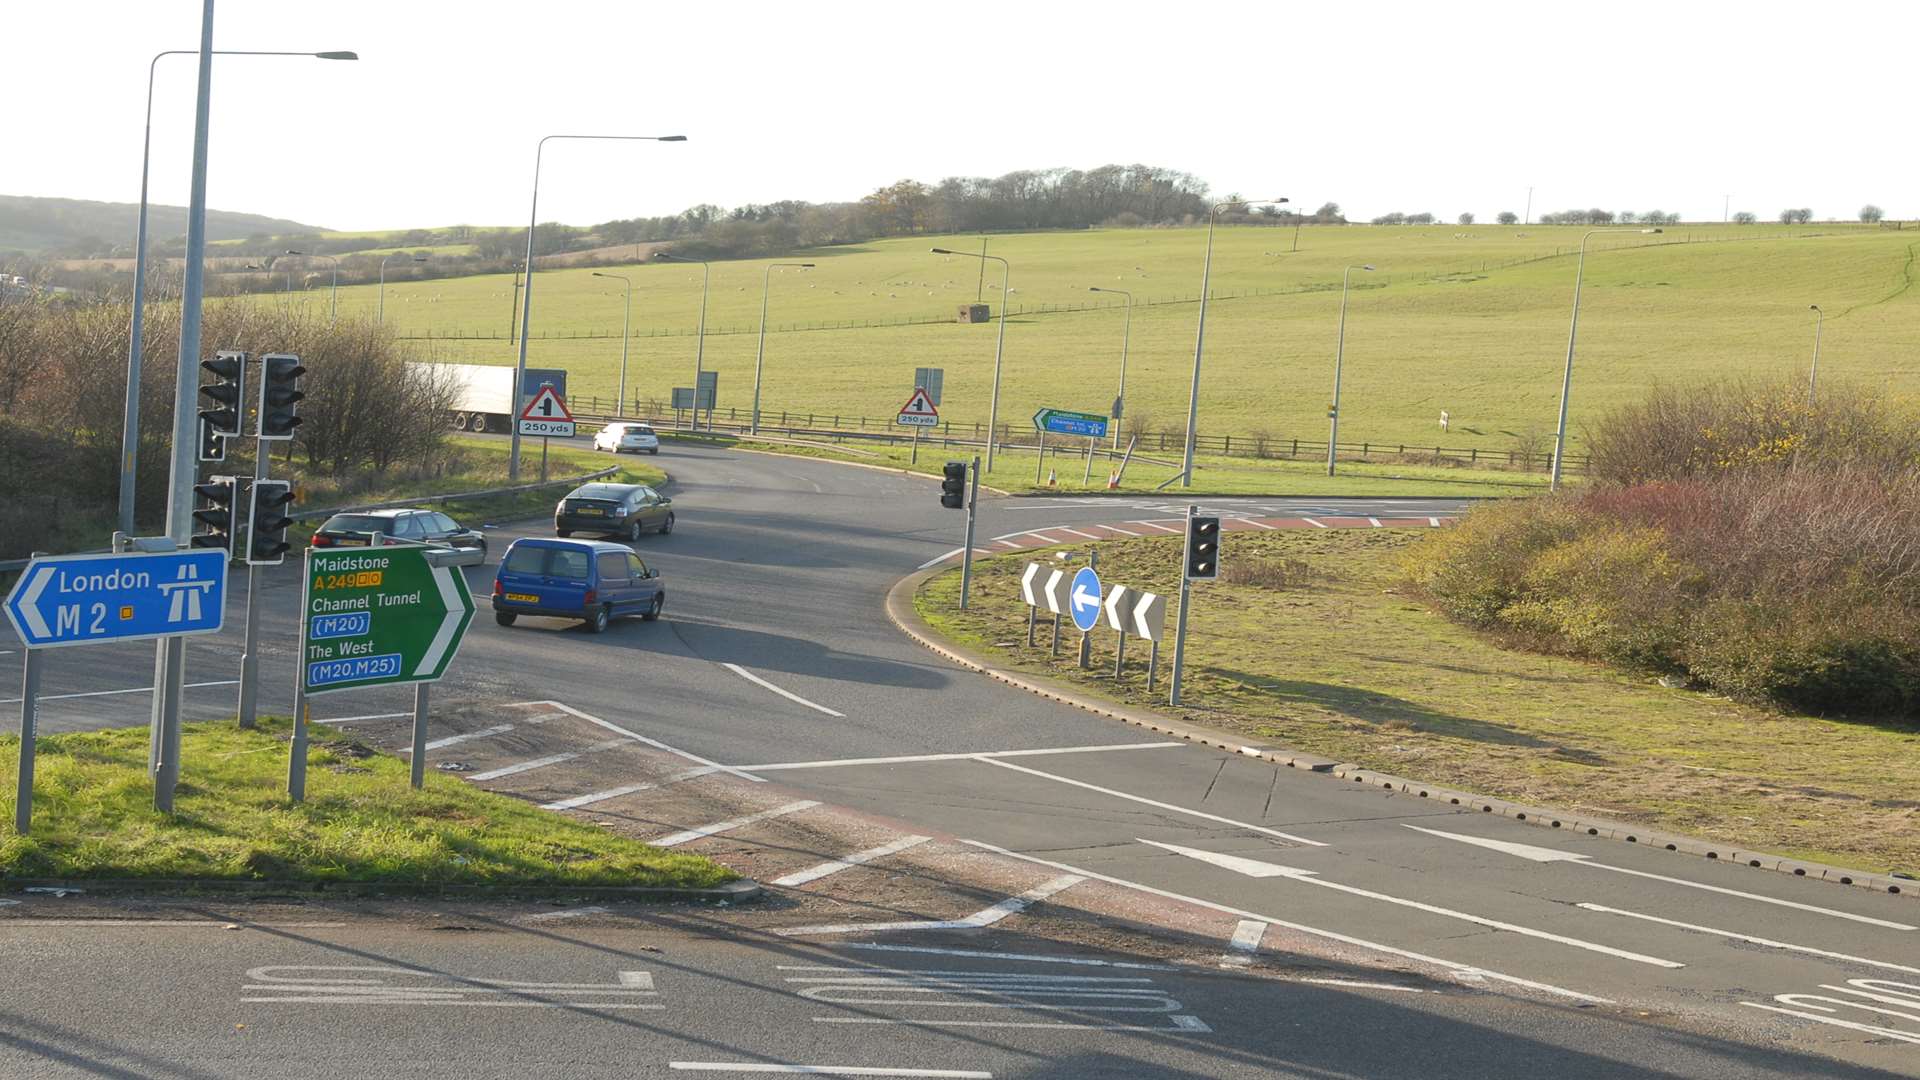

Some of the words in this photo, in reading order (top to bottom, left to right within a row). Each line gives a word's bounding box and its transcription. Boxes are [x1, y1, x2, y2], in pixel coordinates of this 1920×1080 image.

[525, 422, 548, 431] 250
[550, 424, 569, 433] yds
[902, 415, 919, 423] 250
[314, 556, 389, 572] Maidstone
[60, 568, 149, 593] London
[312, 594, 370, 612] Channel
[376, 590, 421, 607] Tunnel
[316, 616, 365, 636] (M20)
[309, 645, 333, 659] The
[339, 640, 375, 655] West
